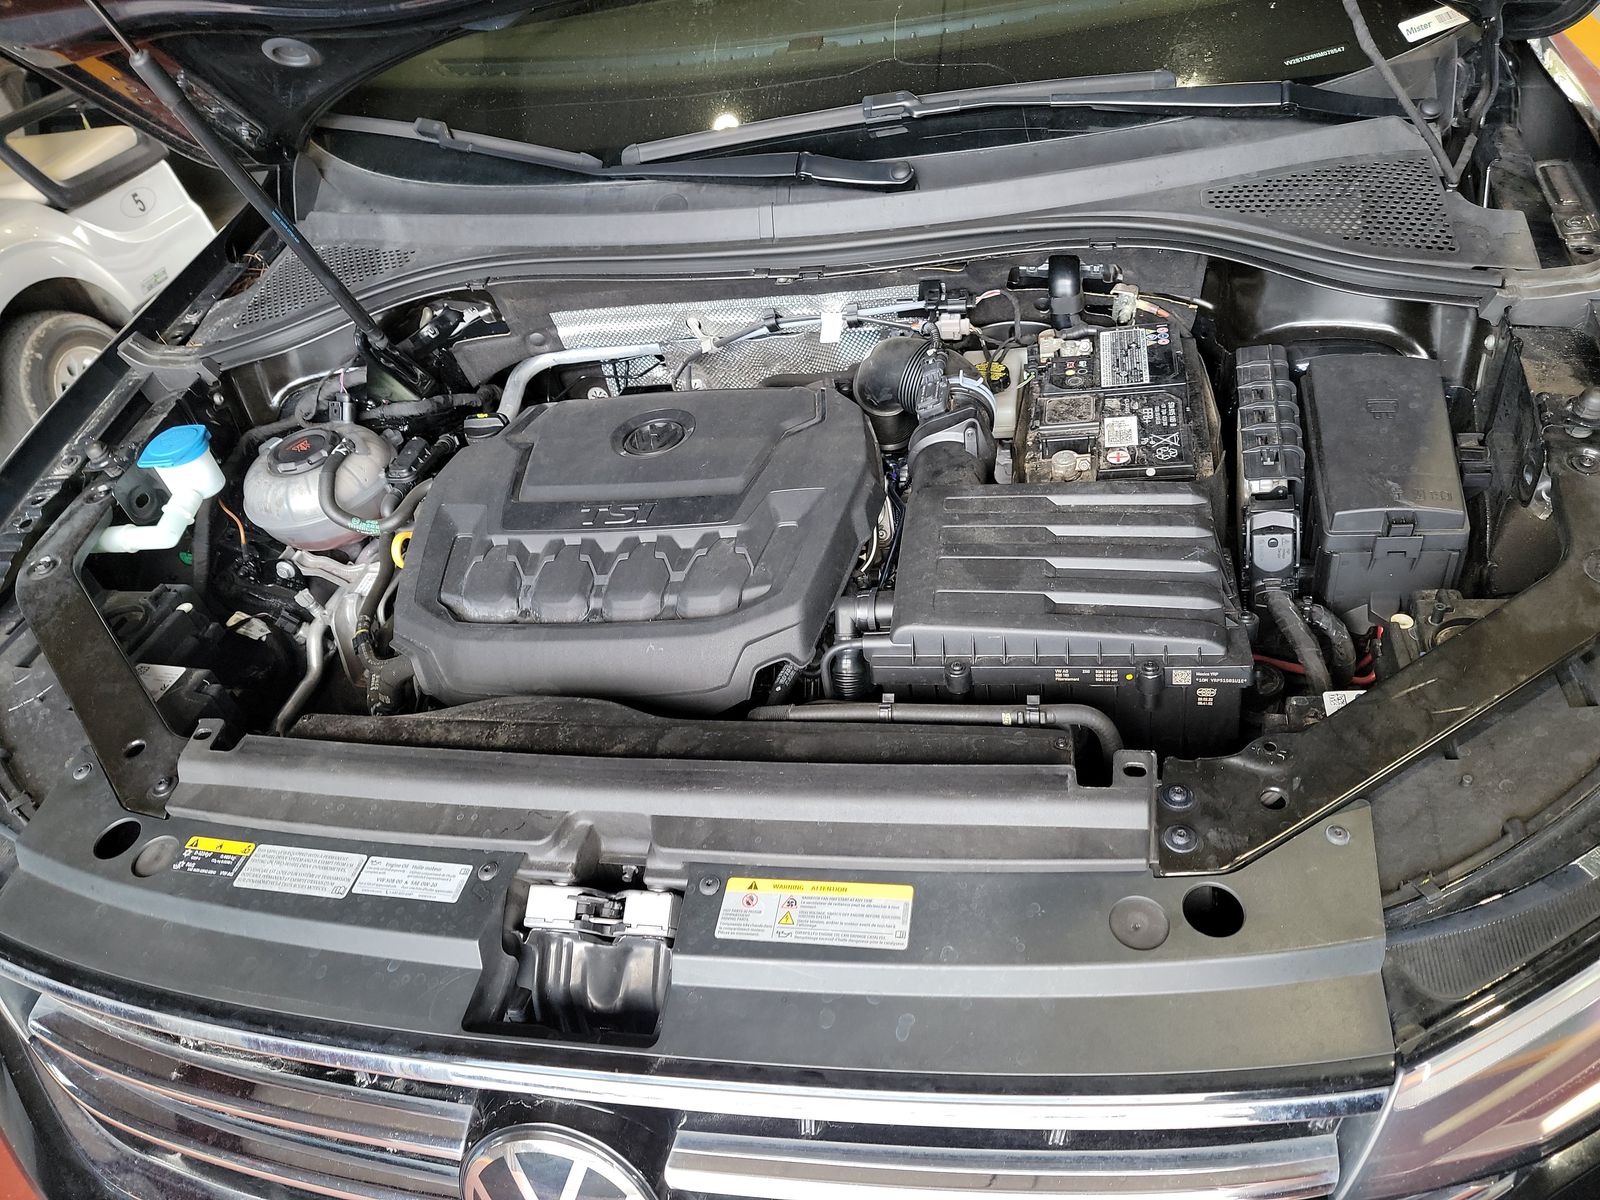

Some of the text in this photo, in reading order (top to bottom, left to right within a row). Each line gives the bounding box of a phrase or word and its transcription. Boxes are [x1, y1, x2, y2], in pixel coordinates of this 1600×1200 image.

[1406, 22, 1432, 36] Mister
[131, 192, 146, 212] 5
[580, 502, 658, 526] TSI
